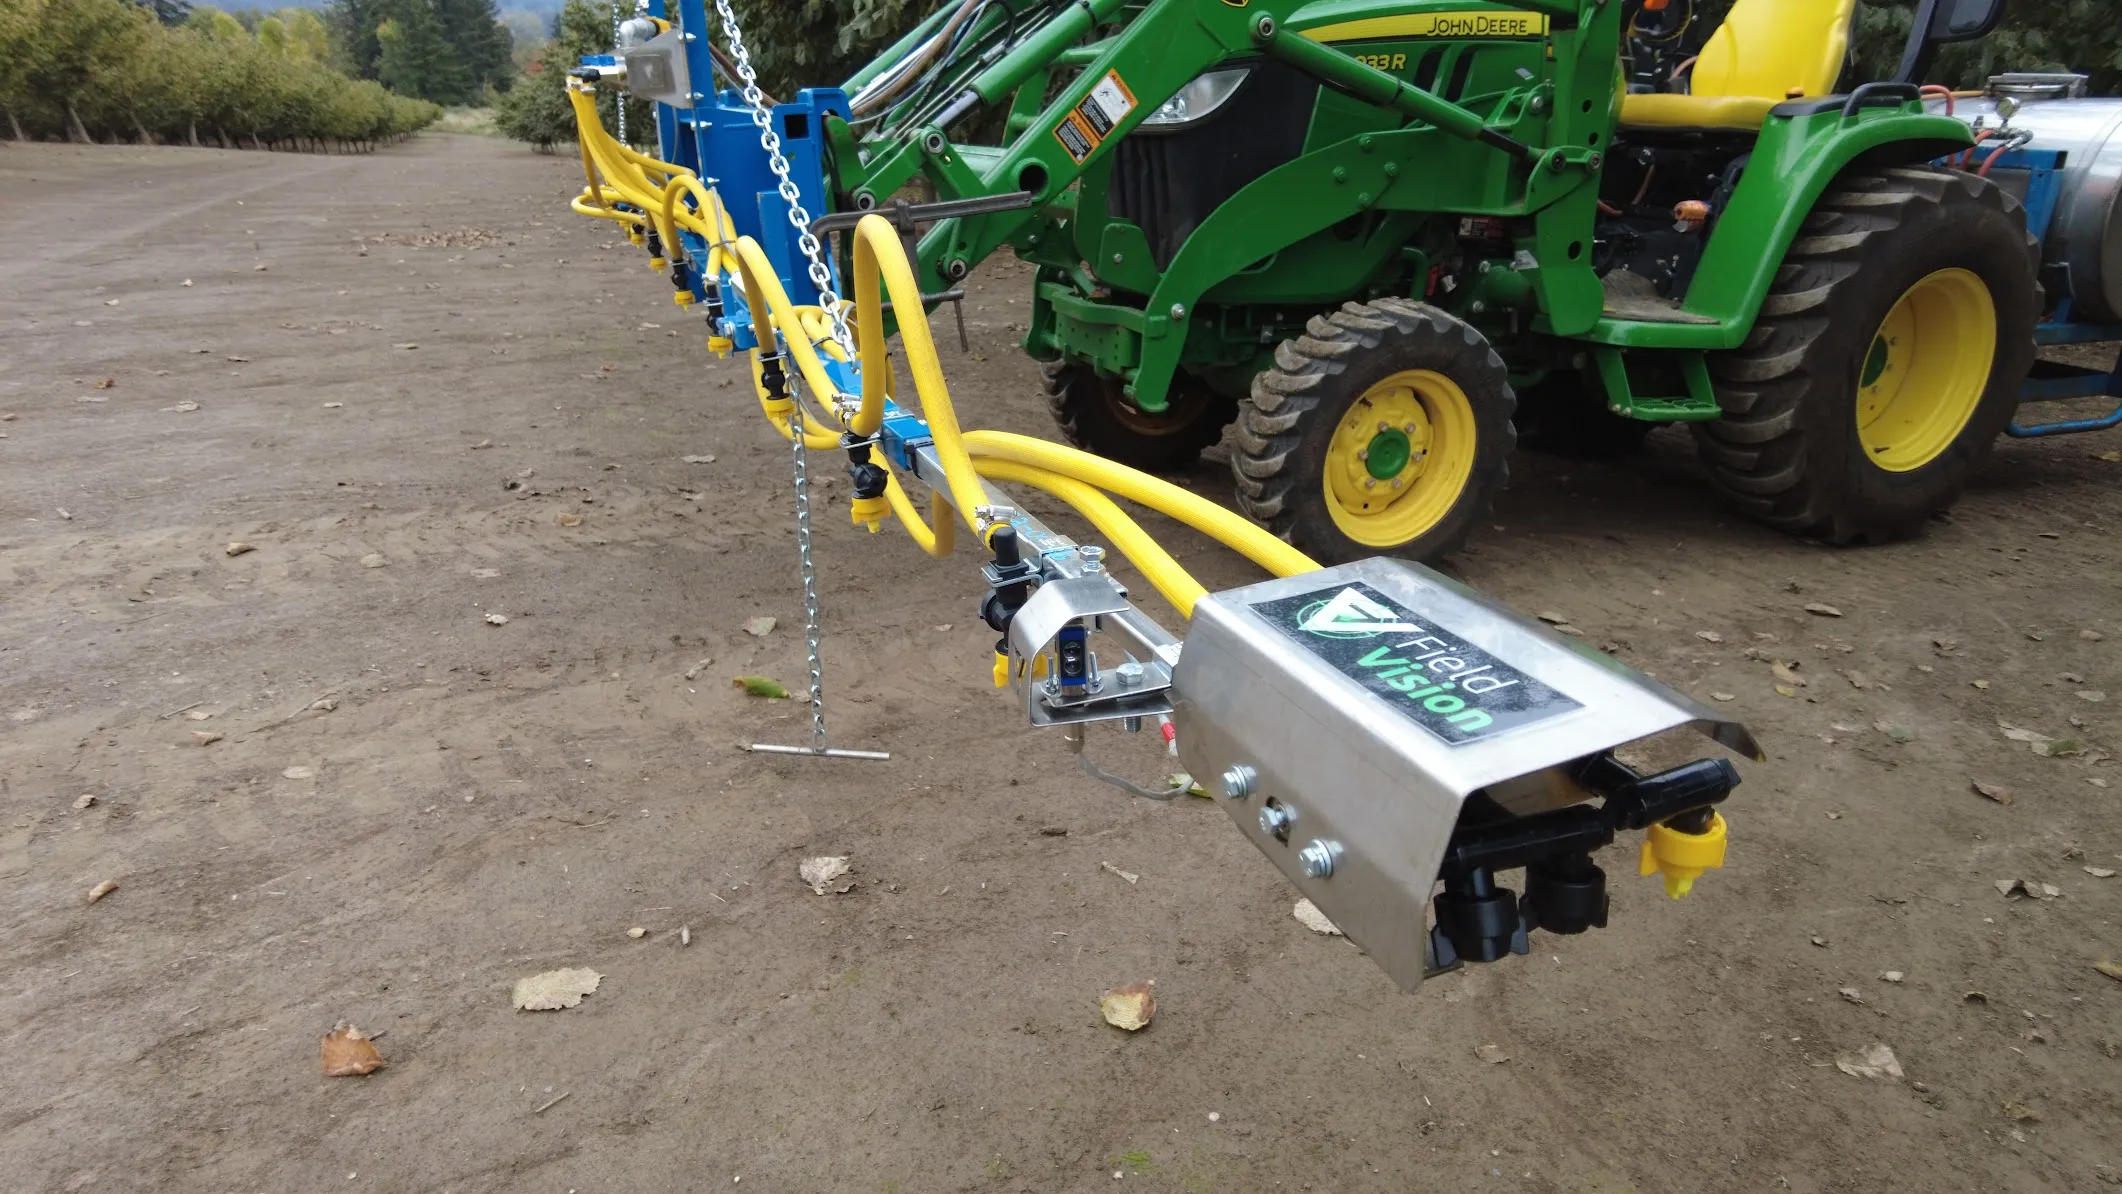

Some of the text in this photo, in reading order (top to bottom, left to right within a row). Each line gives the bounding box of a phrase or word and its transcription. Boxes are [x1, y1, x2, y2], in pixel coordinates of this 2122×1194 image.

[1427, 16, 1528, 34] JOHN DEERE
[1356, 645, 1494, 732] Vision
[1395, 636, 1520, 694] Field
